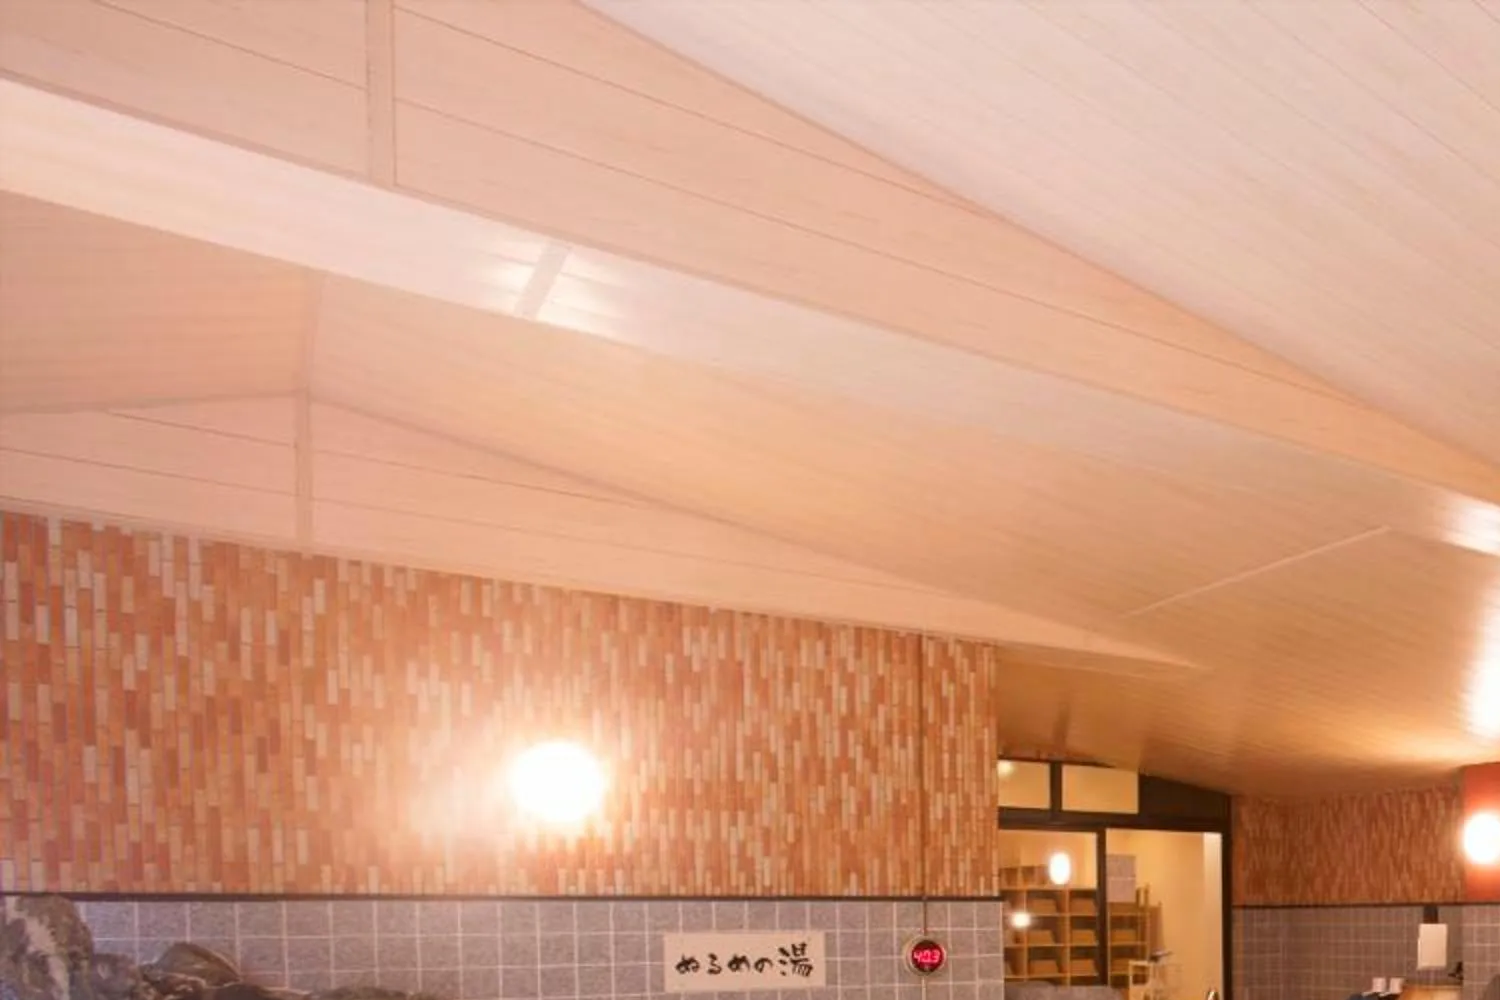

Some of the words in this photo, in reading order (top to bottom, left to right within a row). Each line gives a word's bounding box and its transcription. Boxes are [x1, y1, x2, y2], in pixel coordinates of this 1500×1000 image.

[675, 942, 814, 978] ぬるめの湯
